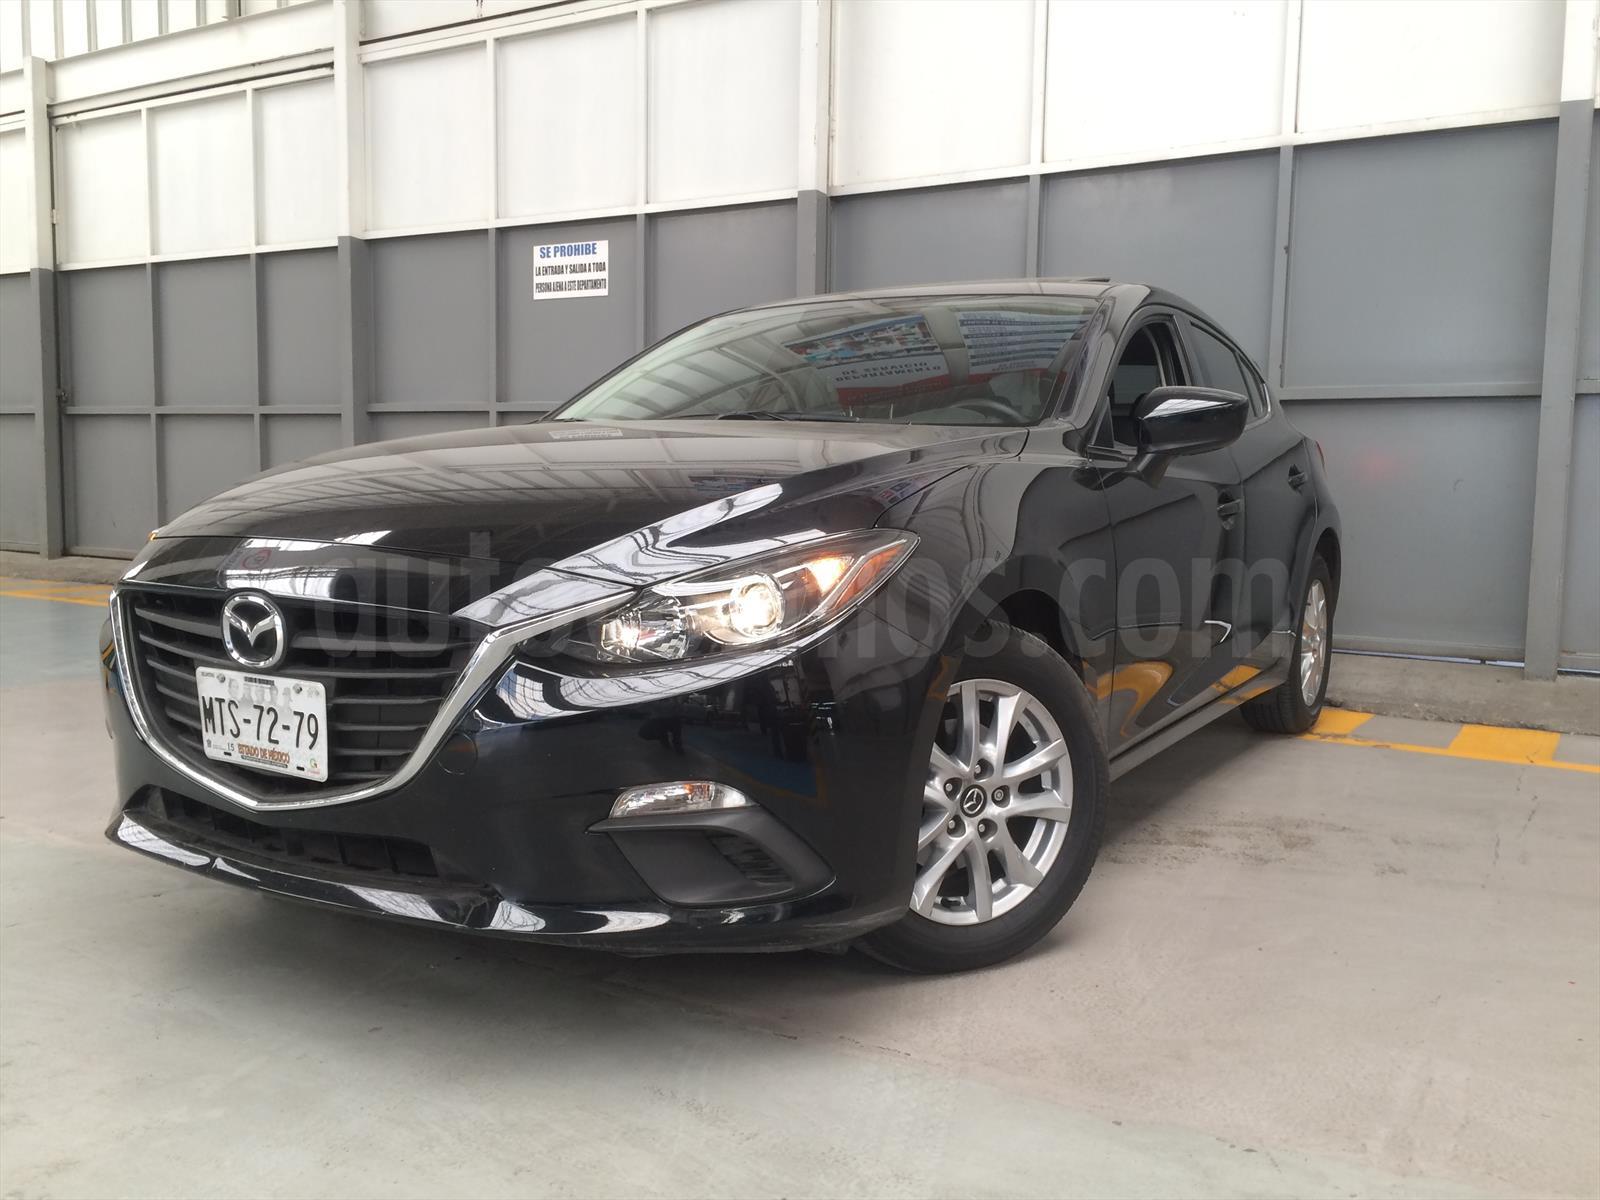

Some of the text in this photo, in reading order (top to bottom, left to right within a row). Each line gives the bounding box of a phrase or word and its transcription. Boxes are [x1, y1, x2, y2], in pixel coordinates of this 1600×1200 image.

[540, 243, 597, 258] SE PROHIBE
[535, 266, 541, 276] LA
[542, 264, 564, 276] ENTRADA
[569, 263, 587, 274] SALIDA
[592, 261, 606, 272] TODA
[535, 282, 552, 293] PERSONA
[201, 695, 320, 750] MTS-72-79
[238, 743, 260, 758] ESTADO
[260, 747, 268, 759] DE
